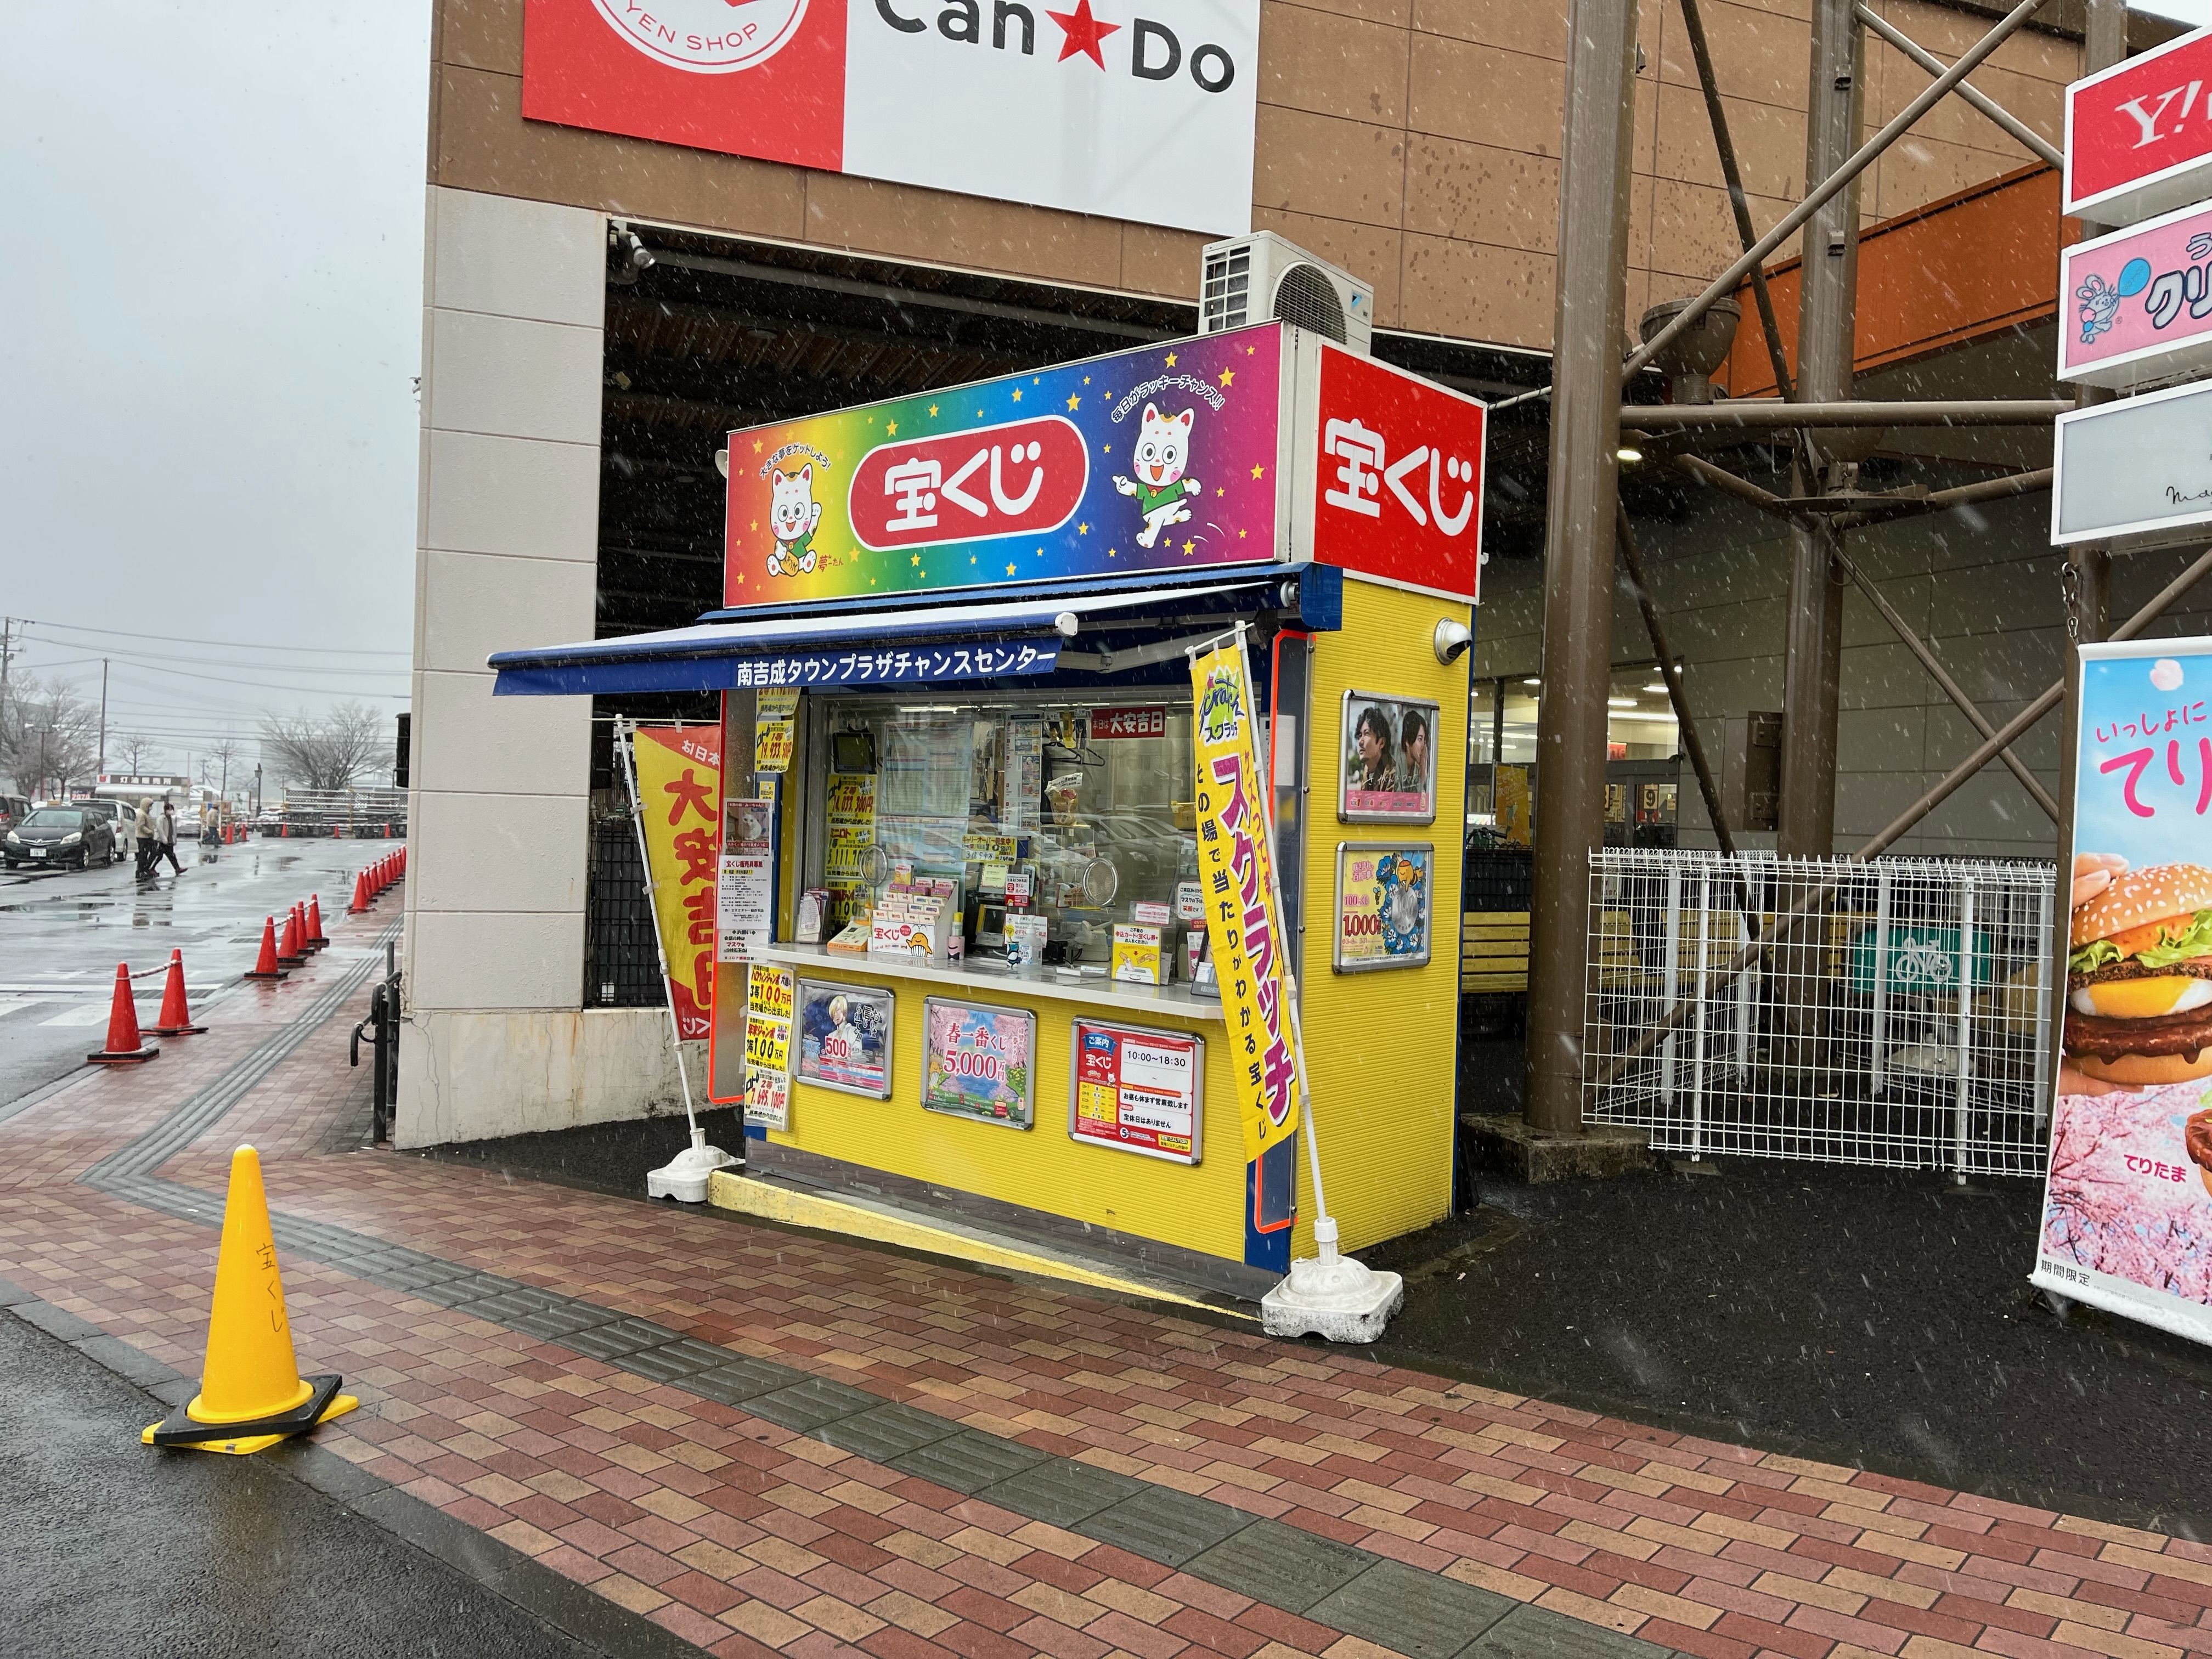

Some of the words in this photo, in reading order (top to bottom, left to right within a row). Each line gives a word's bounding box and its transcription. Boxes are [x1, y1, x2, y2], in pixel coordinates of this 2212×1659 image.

[626, 0, 676, 43] YEN
[686, 22, 758, 51] SHOP
[1132, 18, 1235, 93] Do
[1111, 375, 1226, 422] 毎日がラッキーチャンス!!
[760, 441, 832, 479] 大きな夢をゲットしよう!
[884, 441, 1044, 532] 宝くじ
[1324, 417, 1474, 537] 宝くじ
[737, 645, 1057, 687] 南吉成タウンプラザチャンスセンター
[1093, 719, 1109, 731] 本日は
[1110, 711, 1163, 734] 大安吉日
[1204, 721, 1238, 743] スクラッチ
[2096, 701, 2207, 742] いっしょに
[874, 927, 899, 941] 宝くじ
[1212, 754, 1296, 1127] スクラッチ
[946, 1023, 1007, 1051] 春一番くじ
[1088, 1036, 1109, 1048] ご案内
[1086, 1053, 1112, 1069] 宝くじ
[1124, 1092, 1188, 1110] お昼も休まず営業致します
[1124, 1113, 1171, 1128] 定休日はありません
[2124, 1154, 2187, 1183] てりたま
[256, 1243, 285, 1333] 宝くじ
[2041, 1259, 2090, 1286] 期間限定
